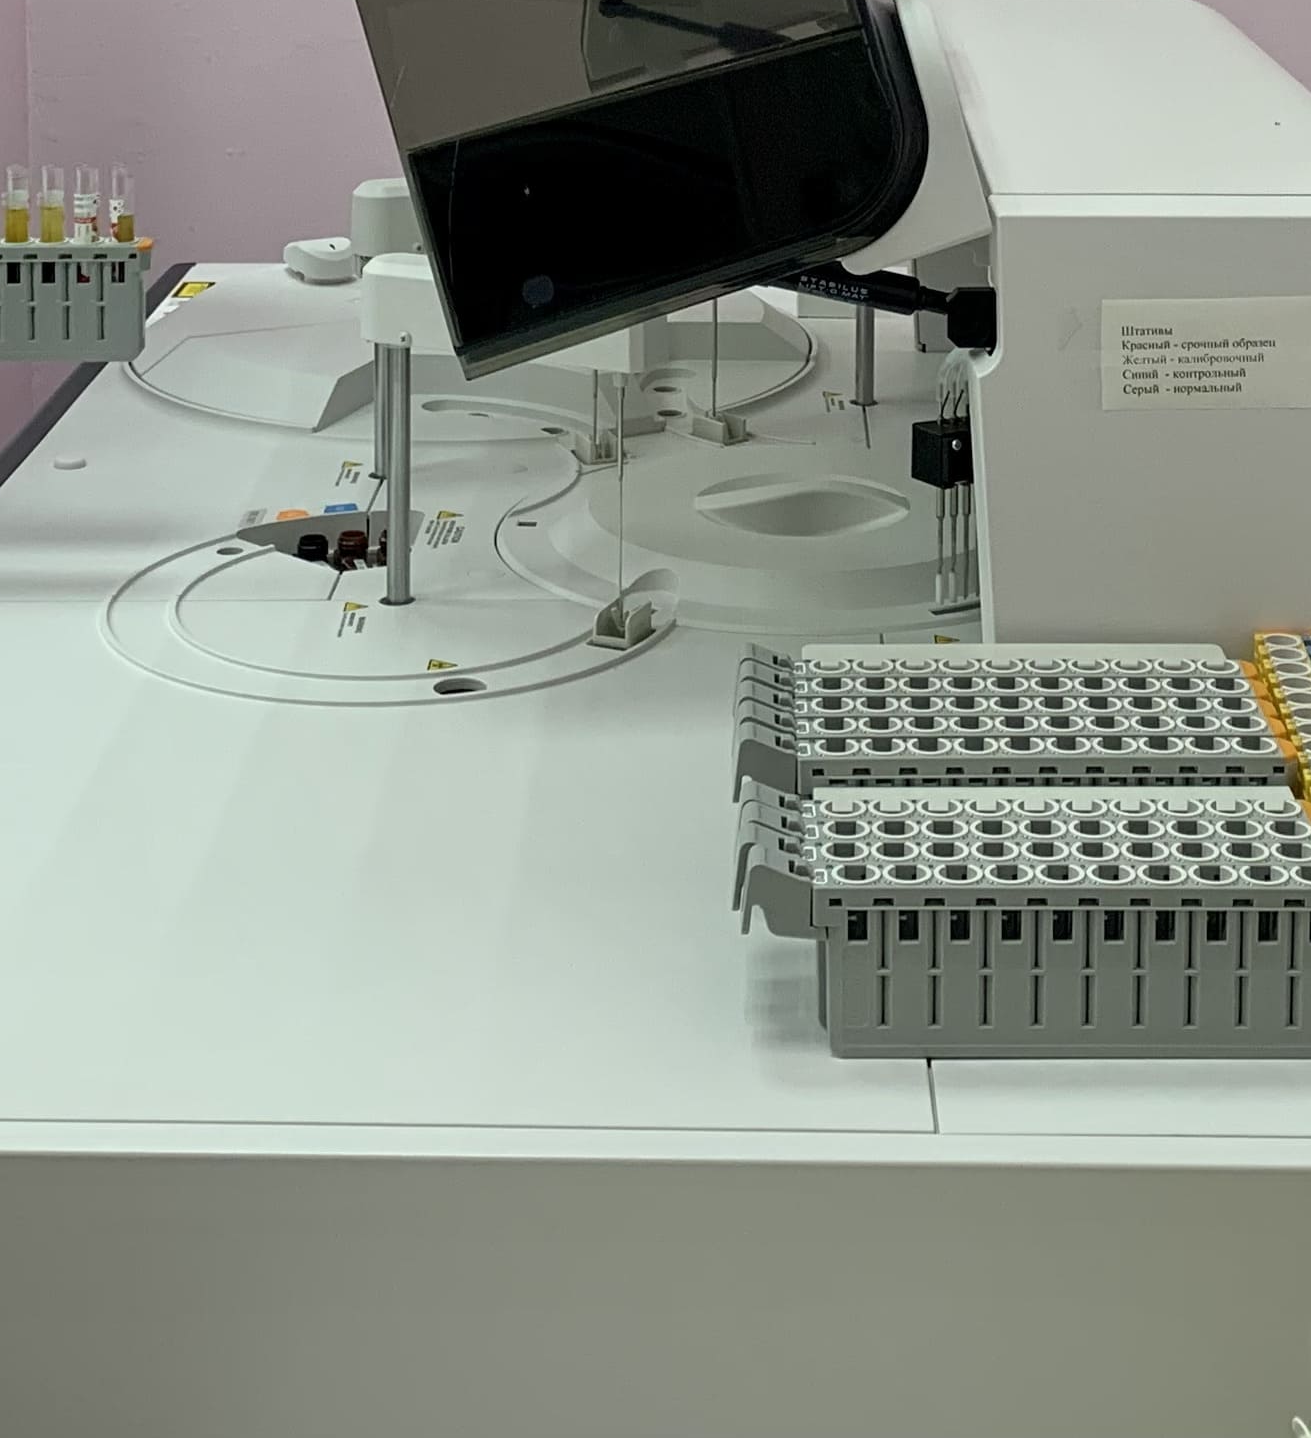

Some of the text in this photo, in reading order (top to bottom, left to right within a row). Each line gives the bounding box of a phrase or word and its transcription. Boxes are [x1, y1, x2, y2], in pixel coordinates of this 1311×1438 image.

[1121, 325, 1173, 337] Штативы
[1122, 340, 1171, 353] Красный
[1181, 339, 1230, 352] срочный
[1232, 337, 1277, 351] образец
[1122, 354, 1168, 366] Желтый
[1177, 352, 1265, 367] калибровочный
[1122, 368, 1159, 380] Синий
[1173, 367, 1247, 382] контрольный
[1123, 383, 1160, 397] Серый
[1173, 382, 1242, 396] нормальный
